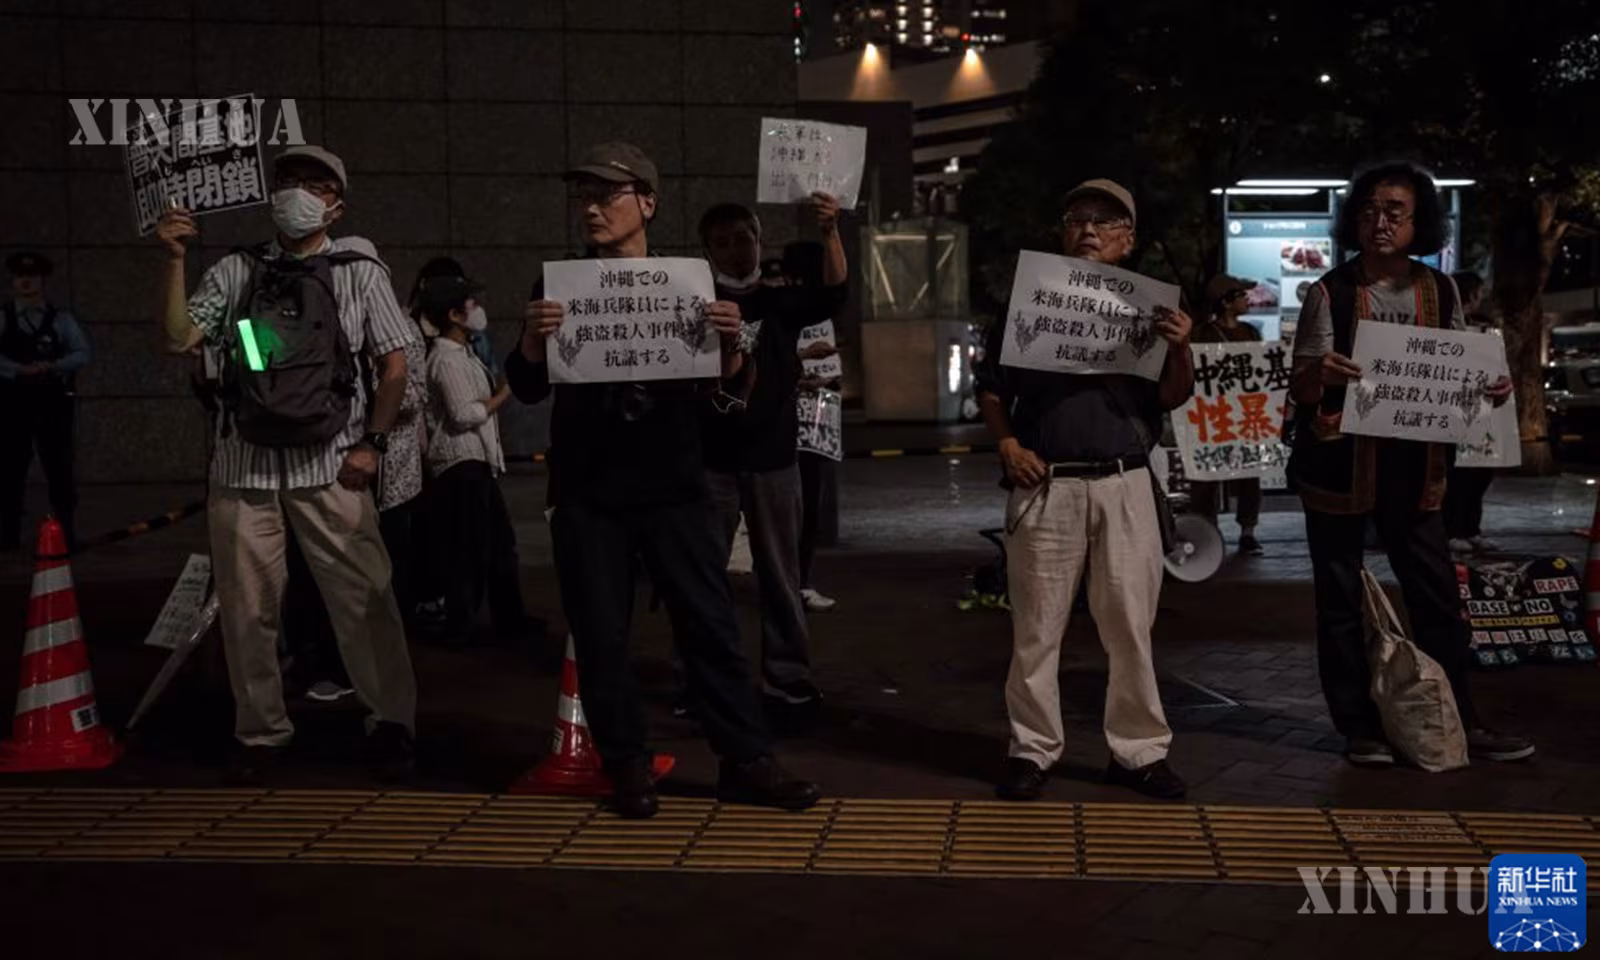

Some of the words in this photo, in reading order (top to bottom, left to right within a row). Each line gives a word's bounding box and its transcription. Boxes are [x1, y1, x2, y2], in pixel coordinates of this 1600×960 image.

[600, 270, 669, 288] 沖縄での
[1067, 269, 1135, 295] 沖縄での
[567, 296, 703, 316] 米海兵隊員による
[1031, 289, 1160, 322] 米海兵隊員によ
[1055, 344, 1117, 363] 抗議する
[1406, 337, 1465, 357] 沖縄での
[603, 349, 671, 368] 抗議する
[1392, 409, 1449, 429] 抗議する
[1534, 576, 1579, 592] RAPE
[1469, 600, 1509, 614] BASE
[1525, 599, 1551, 614] NO
